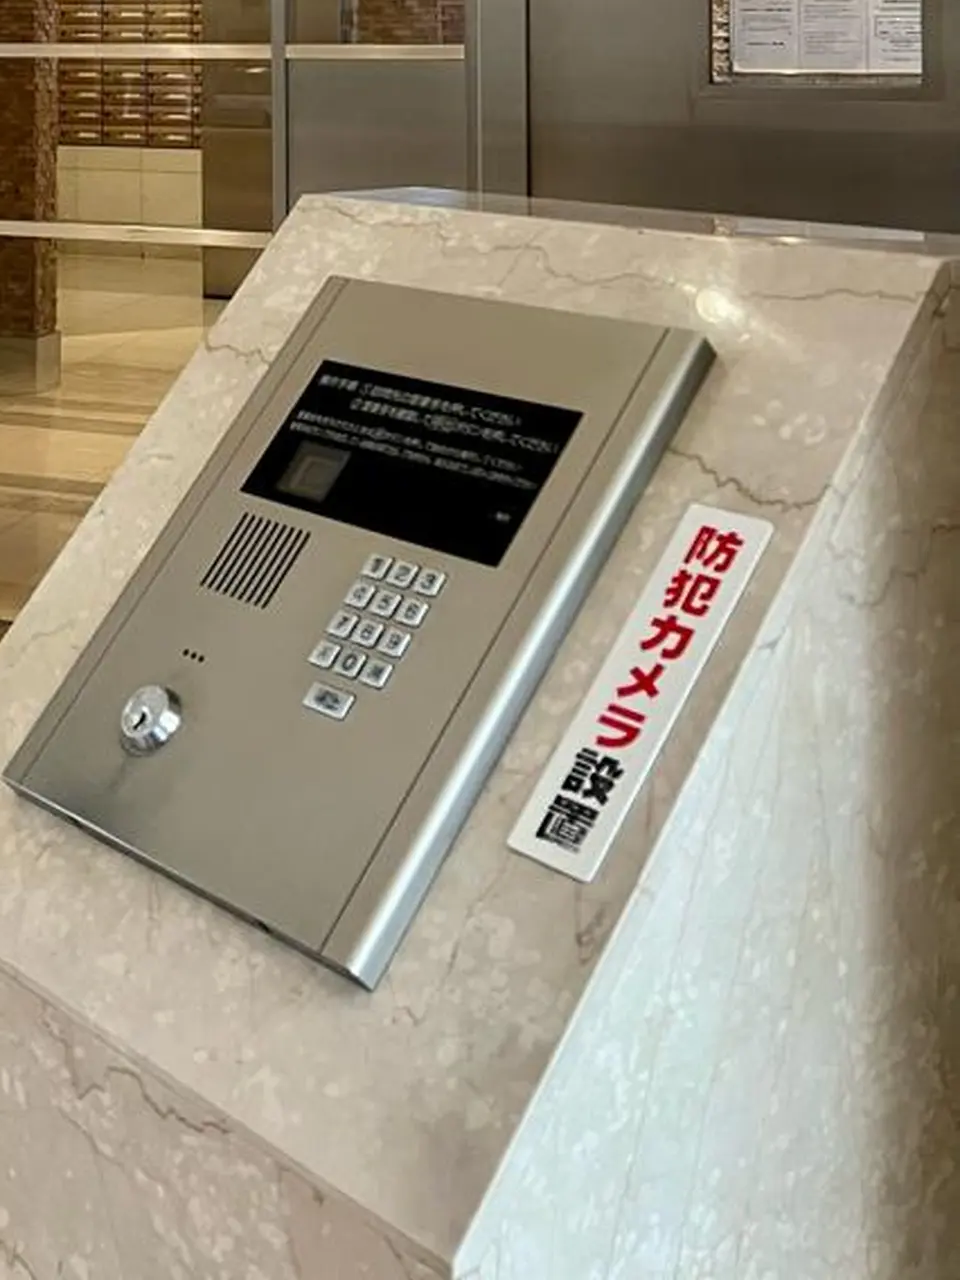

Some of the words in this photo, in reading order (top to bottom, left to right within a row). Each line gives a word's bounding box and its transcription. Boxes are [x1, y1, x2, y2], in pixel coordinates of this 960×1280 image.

[394, 564, 411, 582] 2
[420, 572, 437, 591] 3
[536, 524, 744, 854] 防犯カメラ設置
